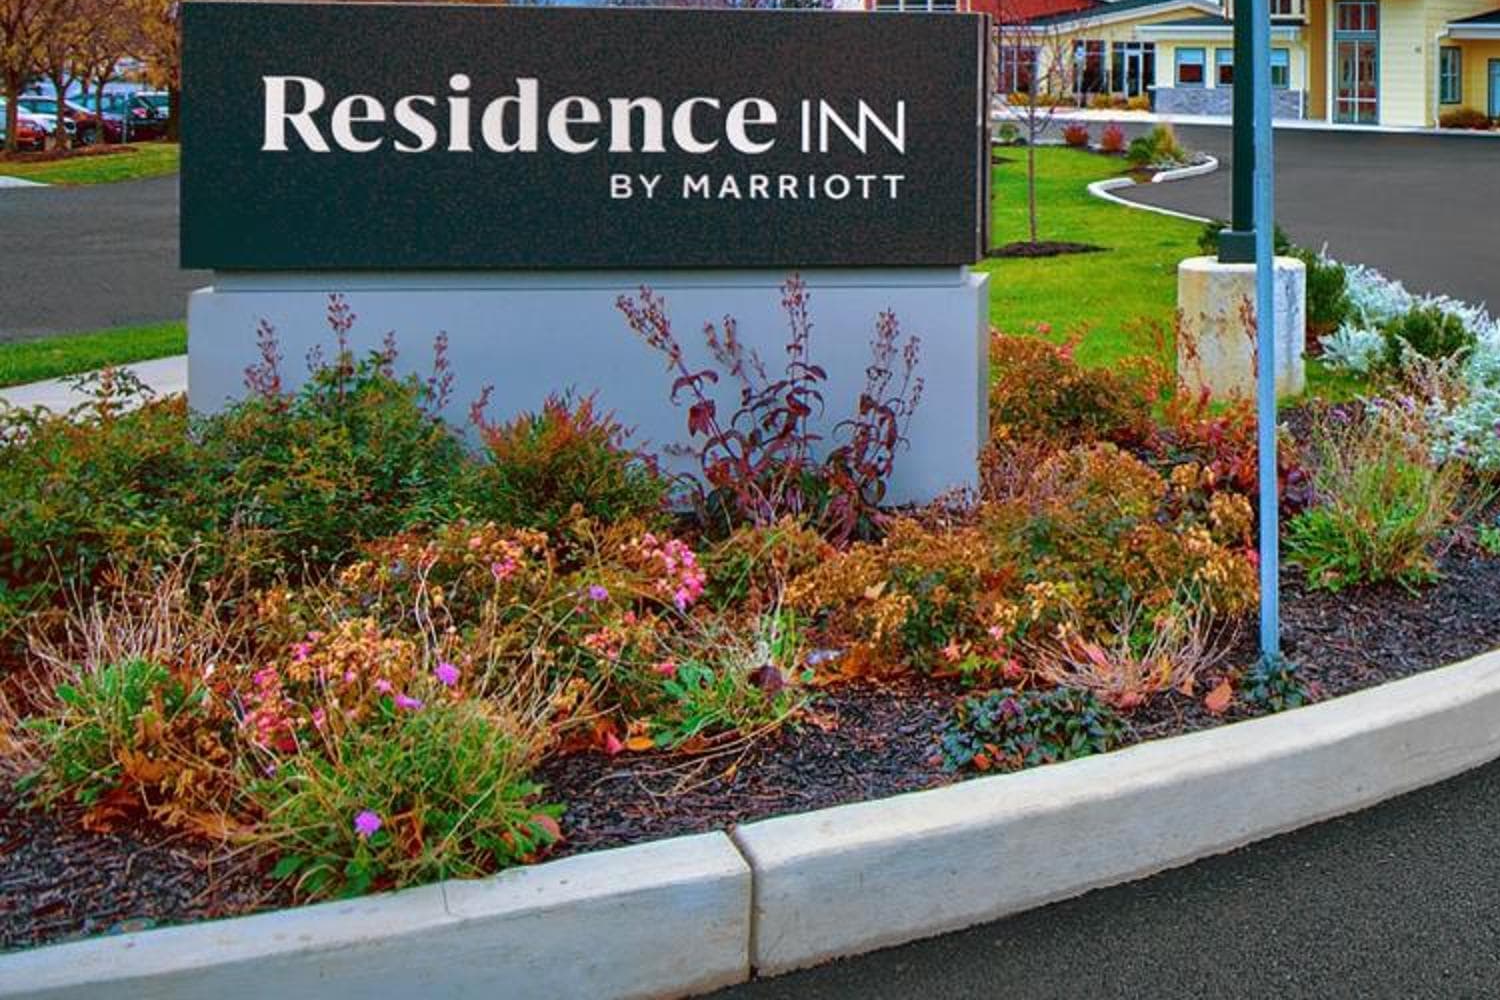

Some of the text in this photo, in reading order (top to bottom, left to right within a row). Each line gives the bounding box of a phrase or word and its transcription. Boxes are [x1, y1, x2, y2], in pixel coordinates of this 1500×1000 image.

[262, 73, 904, 153] Residence INN
[610, 174, 904, 199] BY MARRIOTT
